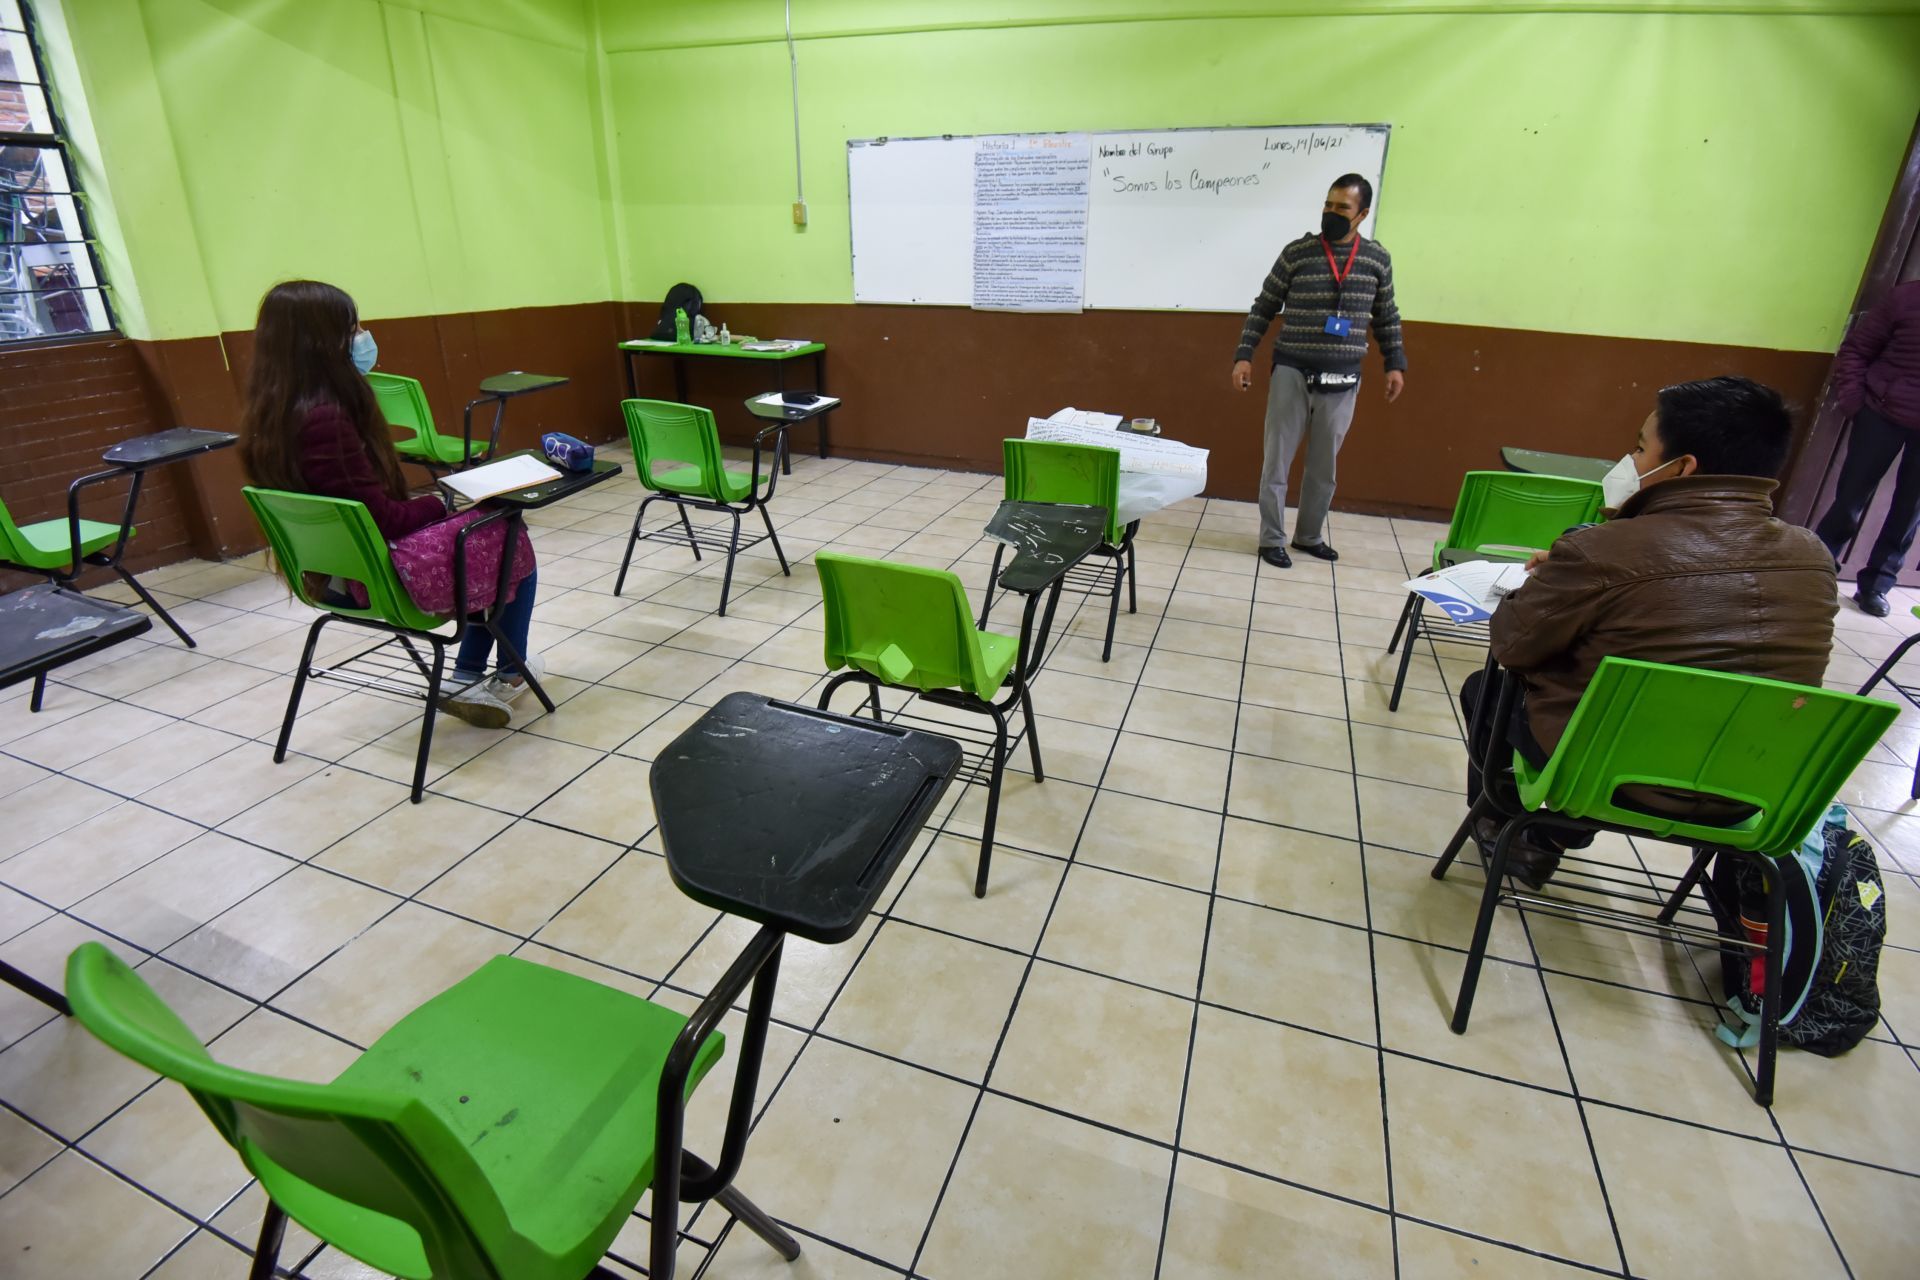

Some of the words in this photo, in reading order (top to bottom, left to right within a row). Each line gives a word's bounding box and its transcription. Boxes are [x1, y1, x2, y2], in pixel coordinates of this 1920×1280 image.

[982, 140, 1009, 150] Historia
[1099, 143, 1126, 158] Nombre
[1147, 142, 1174, 159] Grupo
[1165, 170, 1182, 191] los
